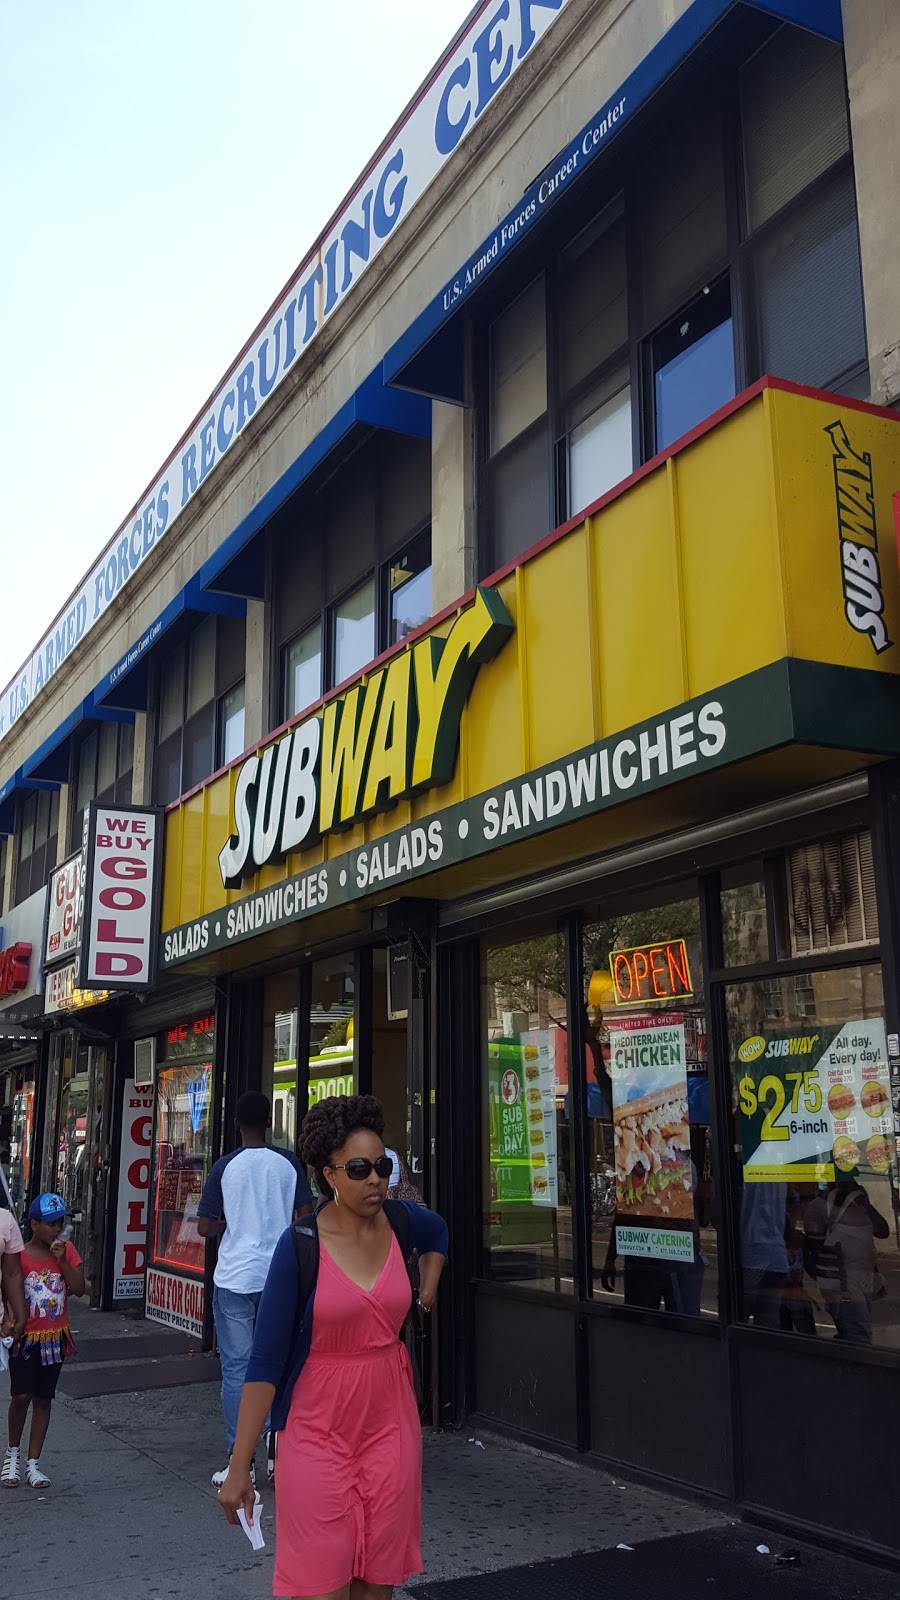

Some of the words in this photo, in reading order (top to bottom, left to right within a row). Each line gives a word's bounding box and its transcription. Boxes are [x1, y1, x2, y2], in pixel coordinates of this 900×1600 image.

[443, 280, 463, 311] U.S.
[464, 238, 499, 289] Armed
[500, 199, 536, 247] Forces
[538, 150, 580, 204] Career
[582, 97, 627, 156] Center
[34, 593, 87, 696] ARMED
[93, 480, 170, 621] FORCES
[180, 147, 409, 507] RECRUITING
[822, 419, 895, 656] SUBWAY
[217, 585, 503, 890] SUBWAY
[105, 817, 147, 834] WE
[164, 919, 209, 962] SALADS
[225, 868, 328, 939] SANDWICHES
[356, 820, 443, 889] SALADS
[482, 701, 727, 841] SANDWICHES
[96, 834, 153, 852] BUY
[94, 856, 149, 978] GOLD
[613, 942, 692, 1001] OPEN
[614, 1030, 680, 1049] MEDITERRANEAN
[764, 1034, 820, 1059] SUBWAY
[836, 1037, 849, 1050] All
[851, 1036, 872, 1049] day.
[614, 1044, 681, 1070] CHICKEN
[829, 1052, 857, 1065] Every
[860, 1047, 881, 1062] day!
[502, 1105, 523, 1125] SUB
[503, 1124, 512, 1136] OF
[511, 1122, 525, 1134] THE
[790, 1119, 828, 1135] 6-inch
[504, 1131, 526, 1152] DAY
[617, 1230, 650, 1244] SUBWAY
[650, 1232, 692, 1249] CATERING
[125, 1287, 144, 1296] REQU
[128, 1279, 145, 1287] PICT
[147, 1271, 167, 1309] CASH
[166, 1276, 184, 1315] FOR
[146, 1305, 171, 1323] HIGHEST
[171, 1313, 190, 1331] PRICE
